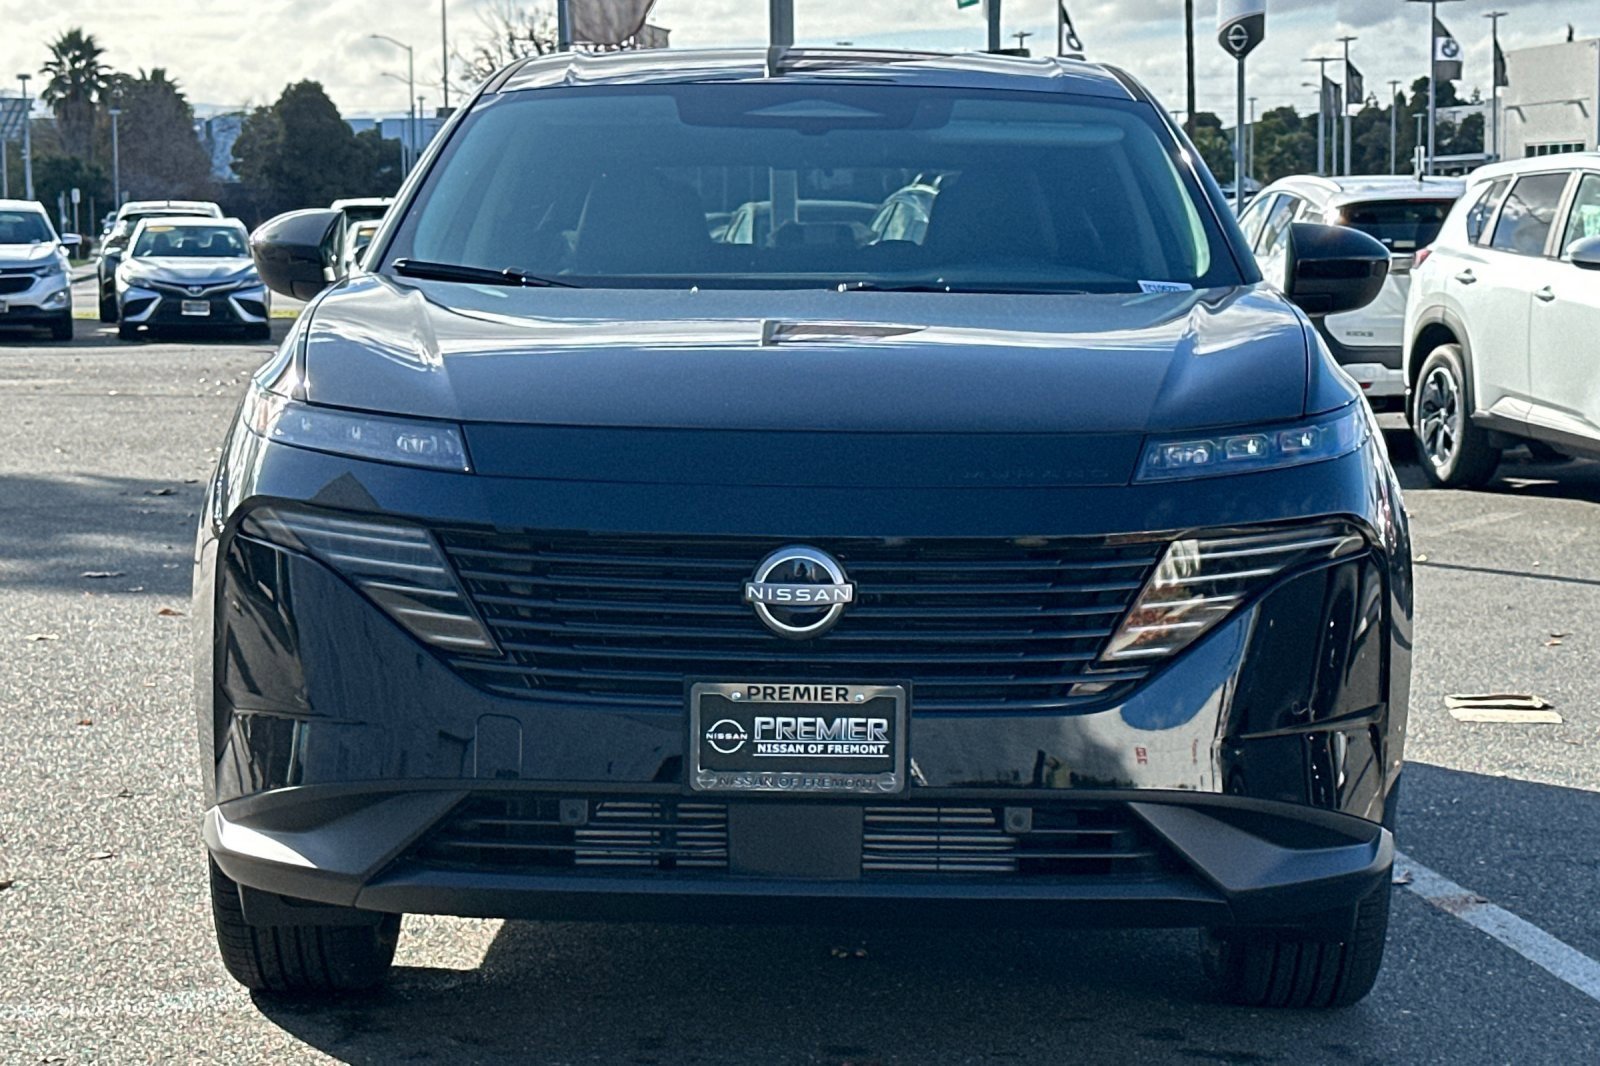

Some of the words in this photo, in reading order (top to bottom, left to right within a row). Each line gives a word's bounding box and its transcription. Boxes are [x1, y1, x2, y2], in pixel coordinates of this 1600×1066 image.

[748, 586, 849, 601] NISSAN
[746, 686, 849, 702] PREMIER
[754, 716, 888, 740] PREMIER
[706, 732, 748, 740] NISSAN
[757, 743, 804, 754] NISSAN
[807, 744, 824, 754] OF
[828, 744, 885, 755] FREMONT
[718, 775, 773, 788] NISSAN
[777, 776, 799, 788] OF
[802, 777, 874, 789] FREMONT
